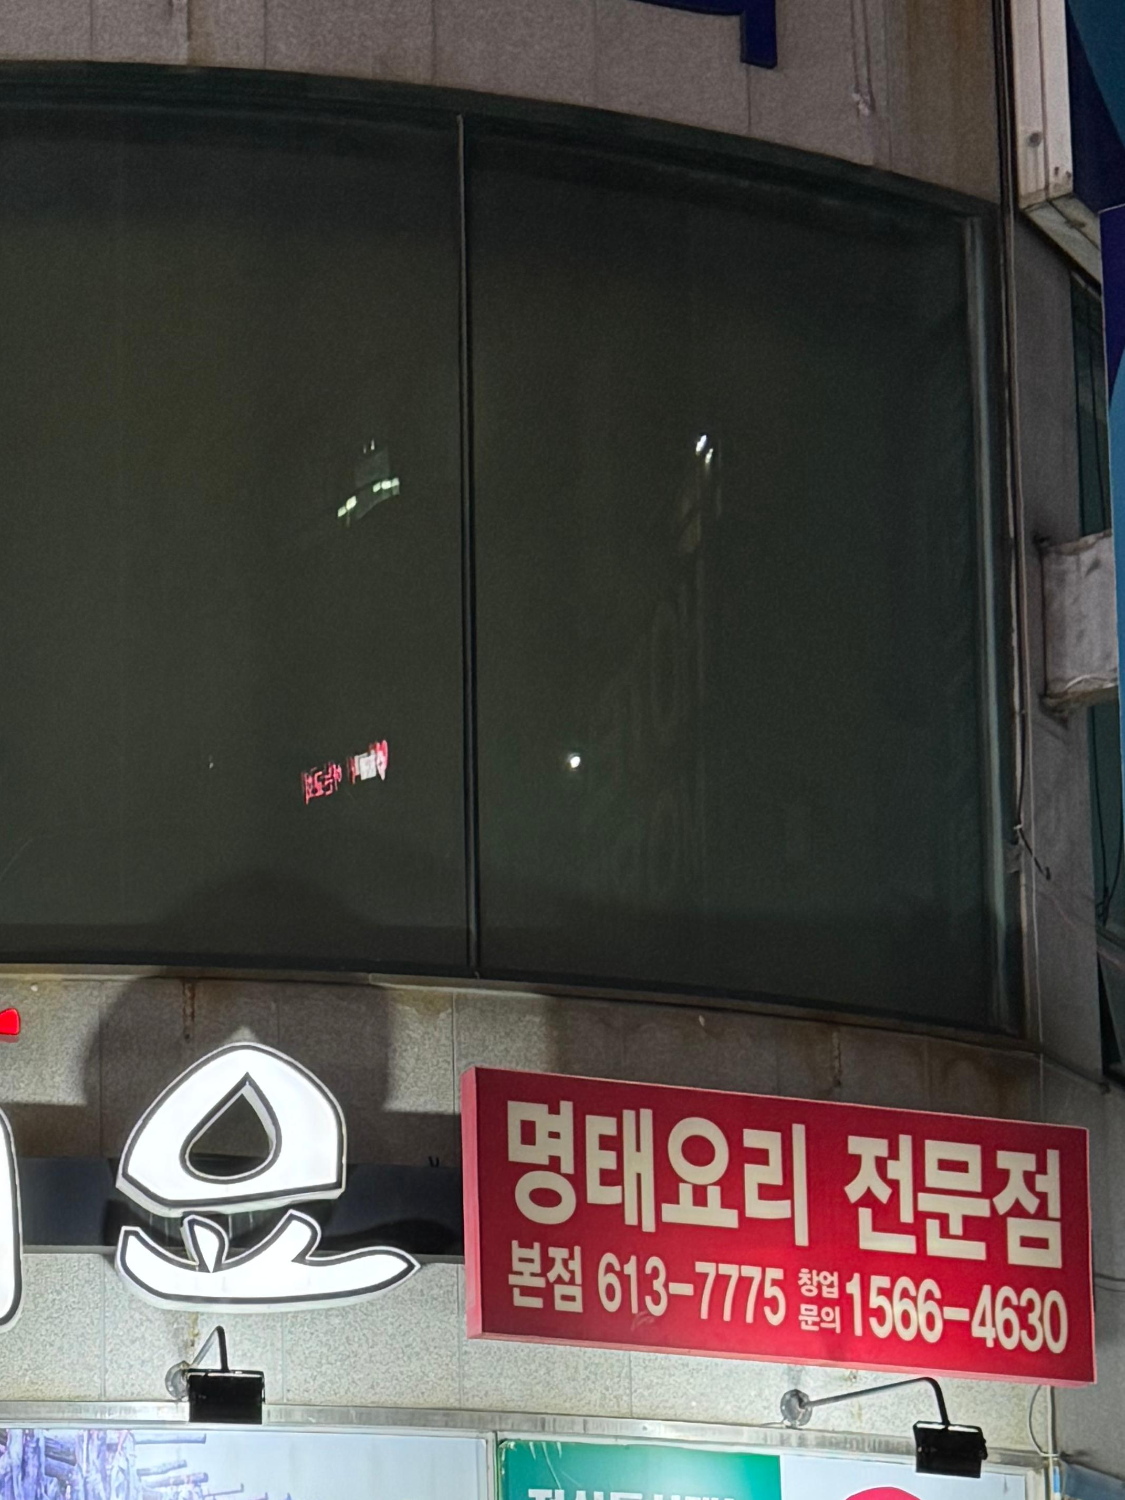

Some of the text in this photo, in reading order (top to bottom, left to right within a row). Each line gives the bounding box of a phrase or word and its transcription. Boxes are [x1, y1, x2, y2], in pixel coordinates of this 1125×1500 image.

[507, 1100, 1063, 1269] 명태요리 전문점
[508, 1239, 786, 1326] 본점 613-7775
[797, 1267, 839, 1298] 창업
[798, 1304, 841, 1333] 문의
[846, 1272, 1068, 1354] 1566-4630
